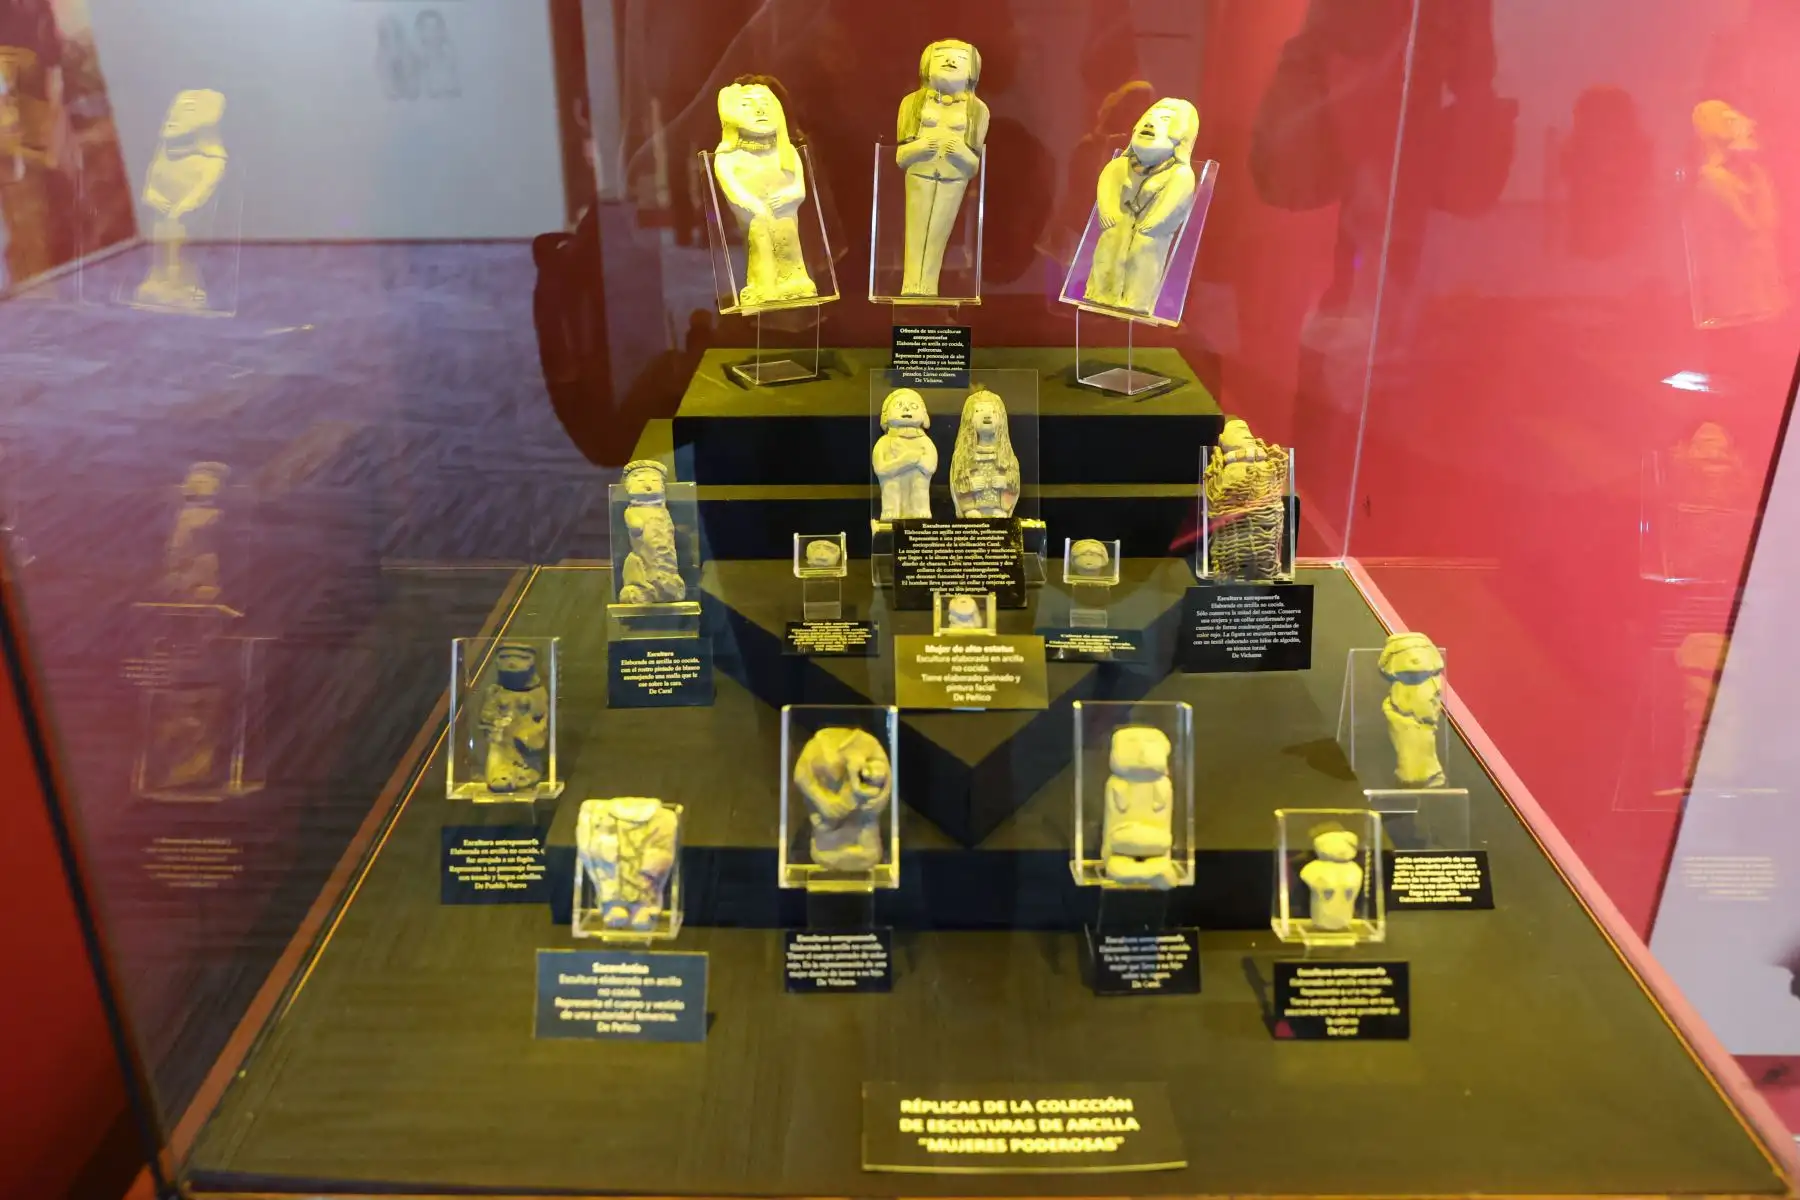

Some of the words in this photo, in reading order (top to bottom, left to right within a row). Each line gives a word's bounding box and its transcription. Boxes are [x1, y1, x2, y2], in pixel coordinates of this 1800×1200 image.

[925, 645, 951, 654] Mujer
[984, 674, 1014, 682] peinado
[900, 1097, 981, 1114] RÉPLICAS
[983, 1100, 1007, 1114] DE
[1009, 1100, 1034, 1114] LA
[1036, 1096, 1134, 1114] COLECCIÓN
[900, 1118, 924, 1132] DE
[926, 1119, 1036, 1133] ESCULTURAS
[1038, 1118, 1064, 1132] DE
[1066, 1118, 1140, 1132] ARCILLA
[918, 1137, 1007, 1153] "MUJERES
[1009, 1136, 1124, 1152] PODEROSAS"
